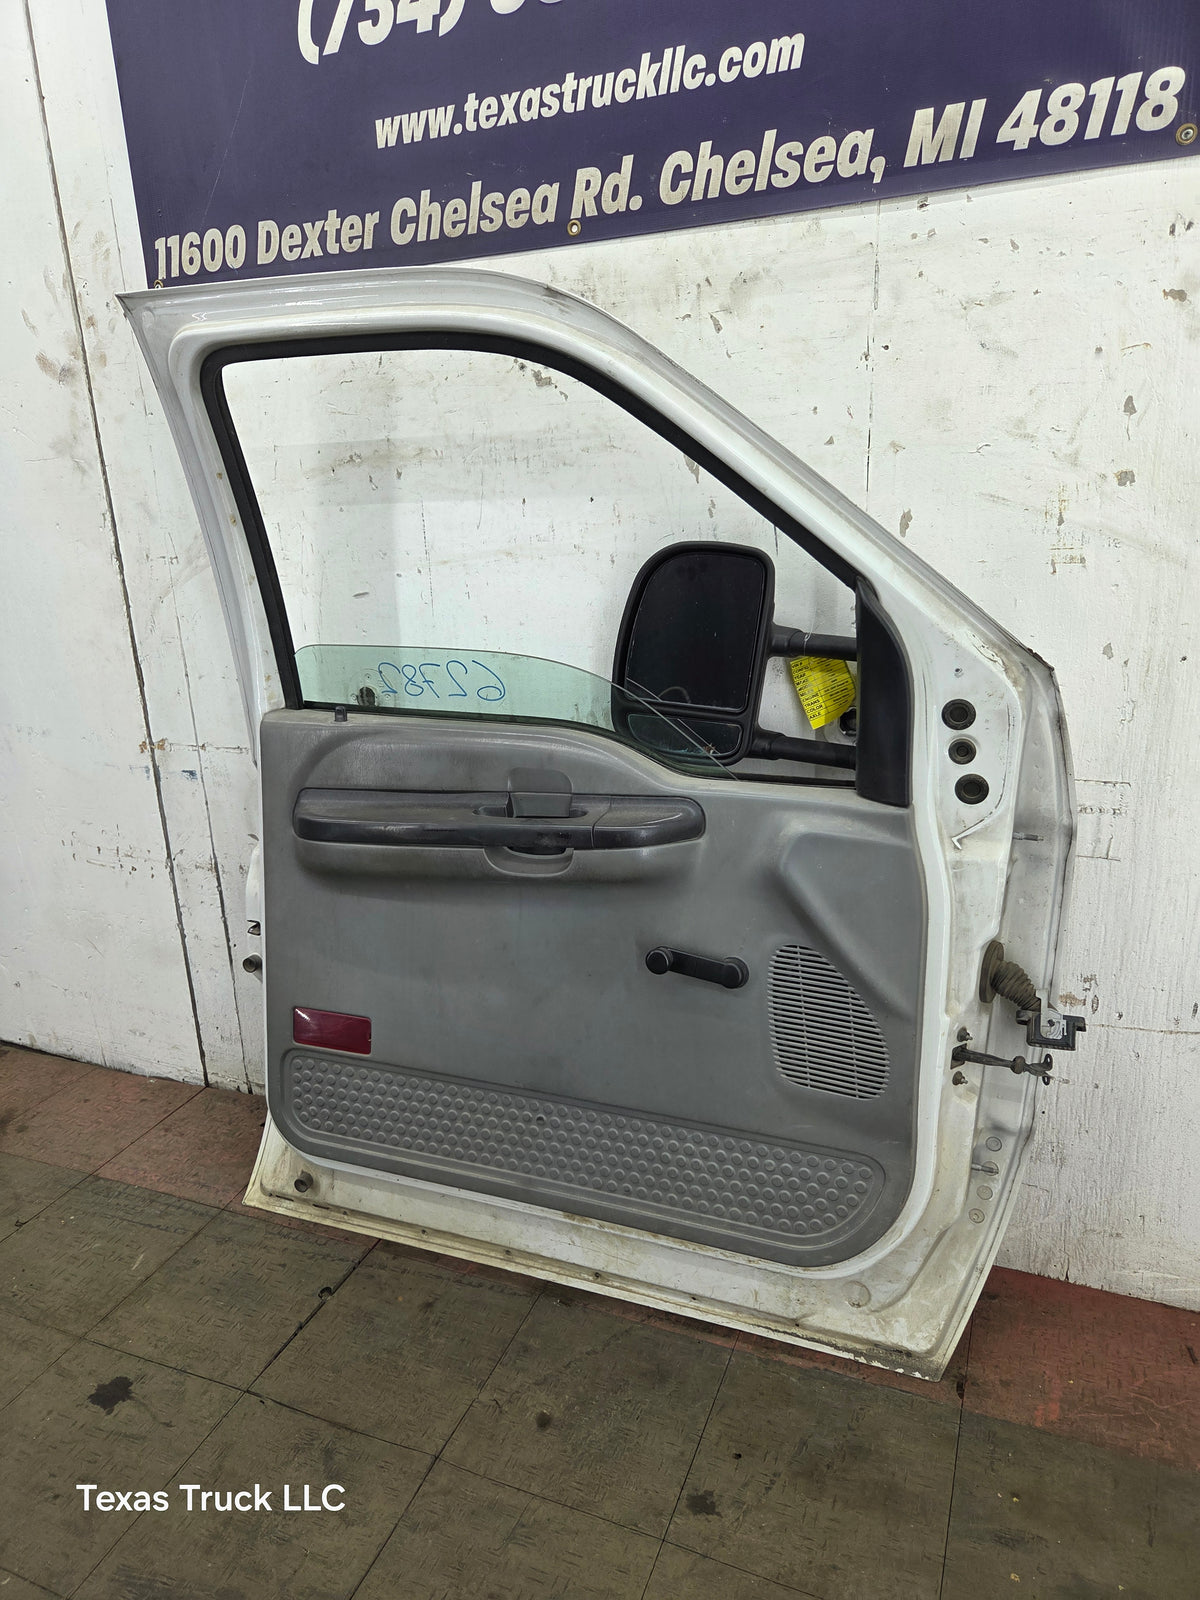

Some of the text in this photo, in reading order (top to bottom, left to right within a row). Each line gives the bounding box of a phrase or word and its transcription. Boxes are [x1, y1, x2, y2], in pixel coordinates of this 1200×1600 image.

[154, 65, 1186, 281] 11600 Dexter Chelsea Rd. Chelsea, MI 48118
[374, 32, 806, 150] www.texastruckllc.com
